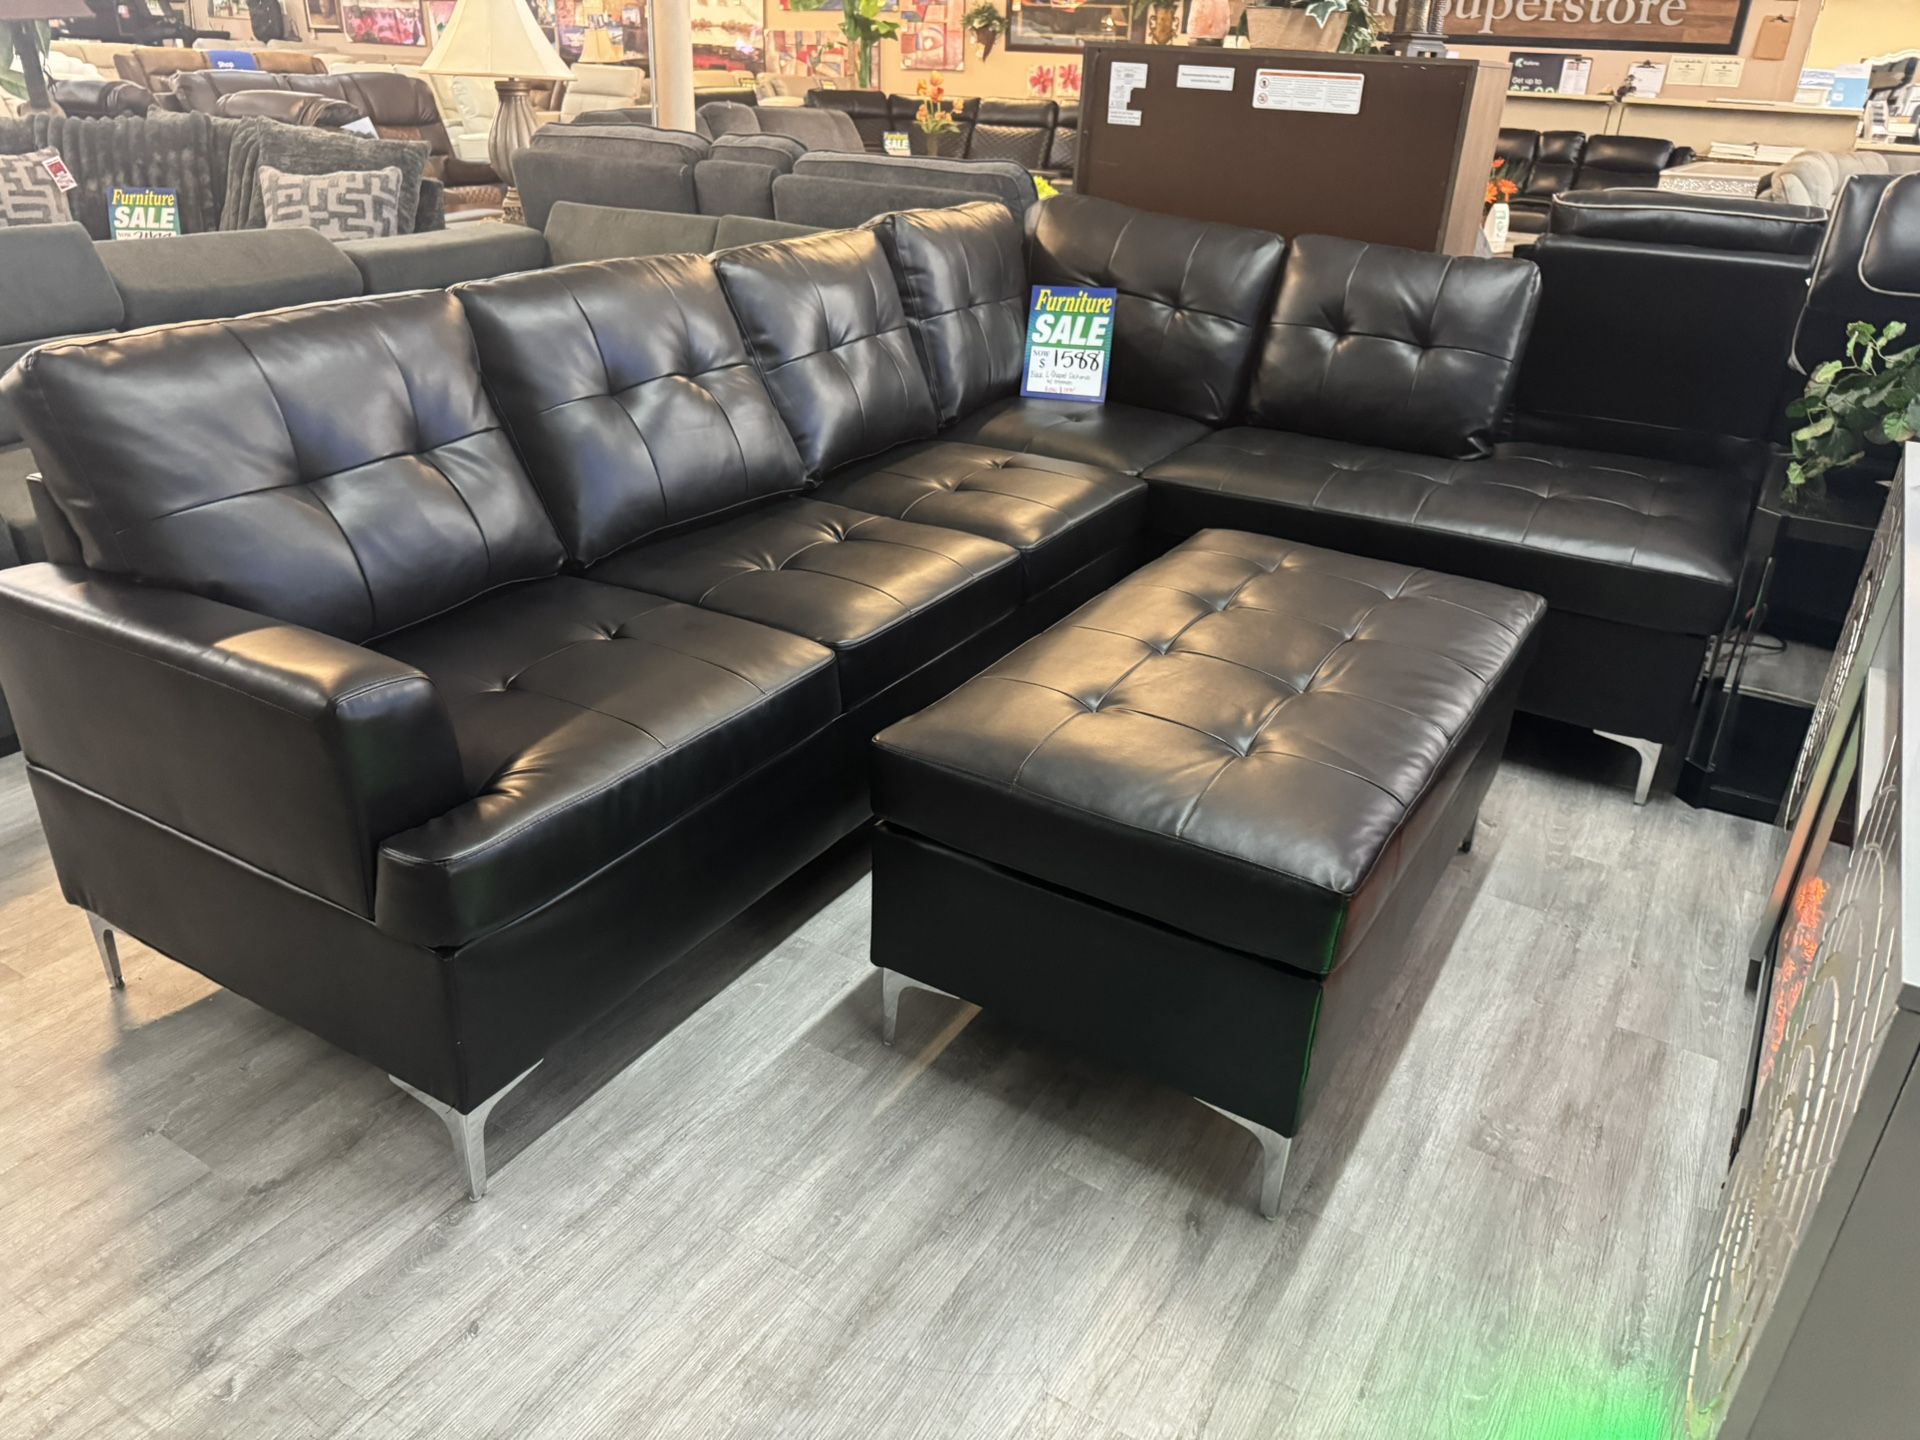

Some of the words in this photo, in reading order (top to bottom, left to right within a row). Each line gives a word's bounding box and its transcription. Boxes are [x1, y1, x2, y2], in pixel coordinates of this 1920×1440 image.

[1437, 0, 1687, 34] uperstore
[884, 140, 910, 150] SALE
[112, 188, 174, 206] Furniture
[114, 207, 175, 228] SALE
[1035, 289, 1112, 313] Furniture
[1031, 314, 1109, 346] SALE
[1039, 358, 1046, 368] $
[1054, 349, 1100, 371] 1588
